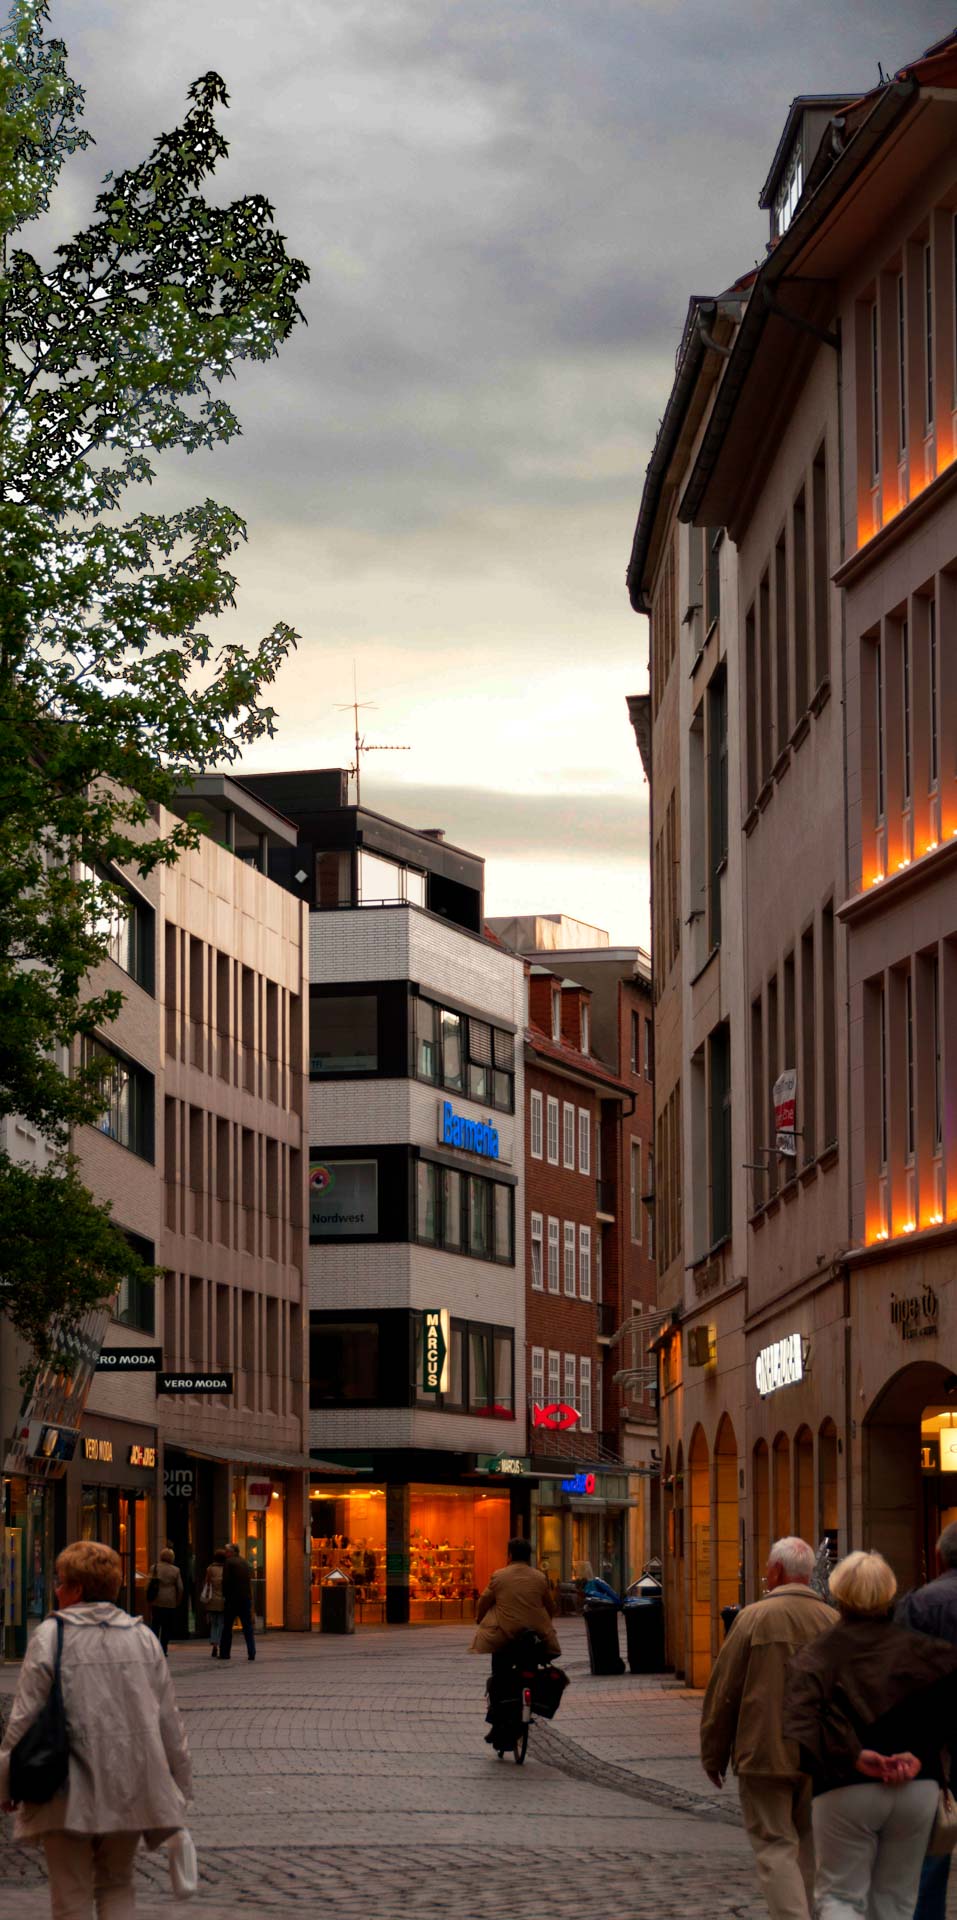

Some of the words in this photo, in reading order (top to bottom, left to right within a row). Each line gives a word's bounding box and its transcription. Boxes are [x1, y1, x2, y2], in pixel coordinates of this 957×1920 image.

[443, 1101, 499, 1158] Barmenia
[312, 1212, 365, 1224] Nordwest
[426, 1313, 439, 1387] MARCUS
[119, 1355, 156, 1365] MODA
[164, 1379, 193, 1388] VERO
[195, 1379, 228, 1388] MODA
